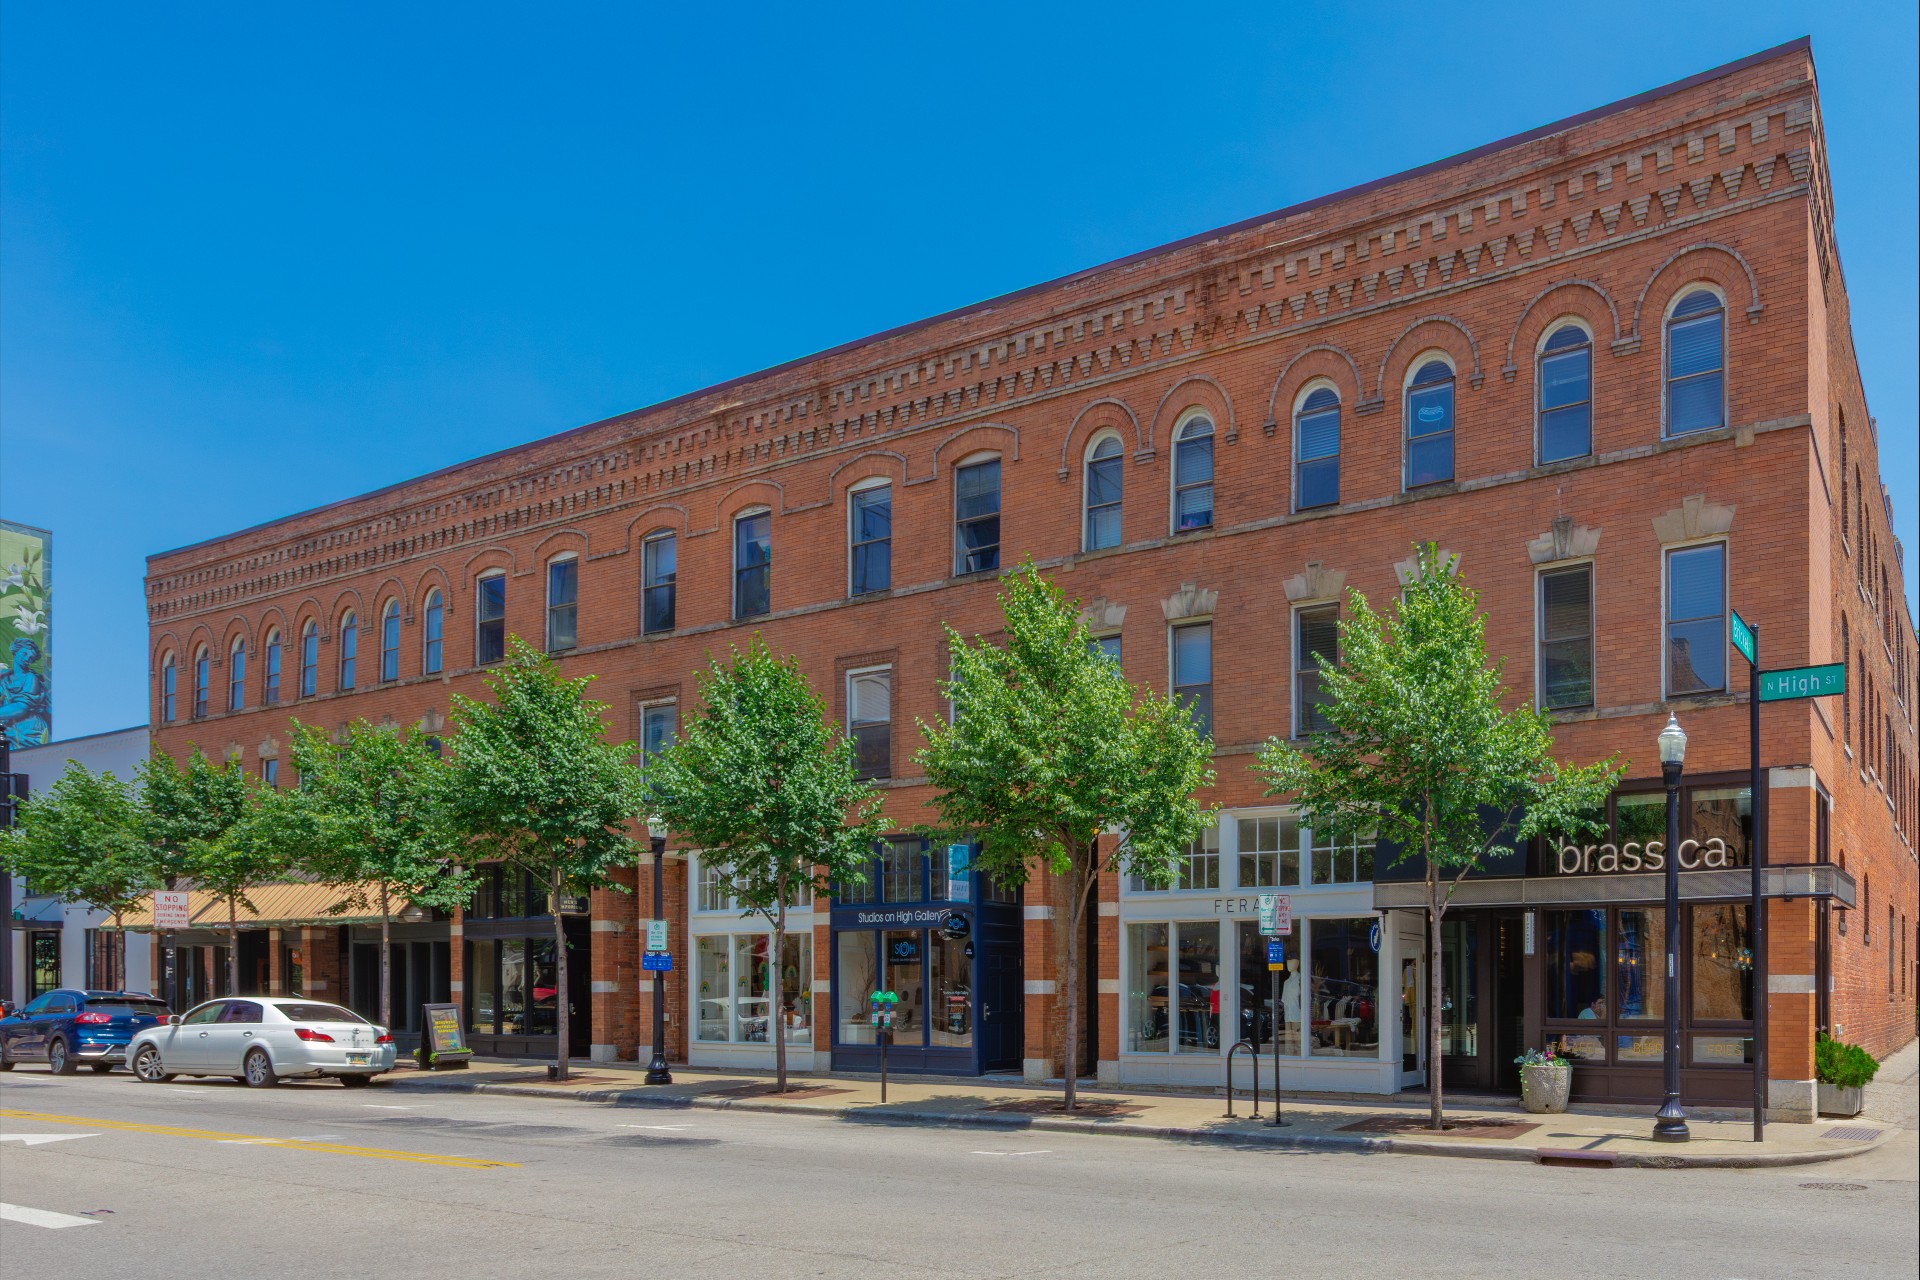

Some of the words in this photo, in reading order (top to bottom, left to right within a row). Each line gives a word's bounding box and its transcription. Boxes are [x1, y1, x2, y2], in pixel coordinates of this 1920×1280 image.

[1768, 682, 1774, 691] N
[1778, 675, 1820, 696] High
[1826, 675, 1837, 685] ST
[1558, 836, 1726, 873] brassca
[858, 912, 884, 923] Studios
[885, 913, 895, 922] on
[896, 911, 913, 924] High
[915, 910, 941, 923] Gallery
[894, 942, 916, 956] SOH
[744, 1024, 763, 1033] rowe
[1633, 1043, 1663, 1055] BEER
[1707, 1044, 1742, 1057] FRIES
